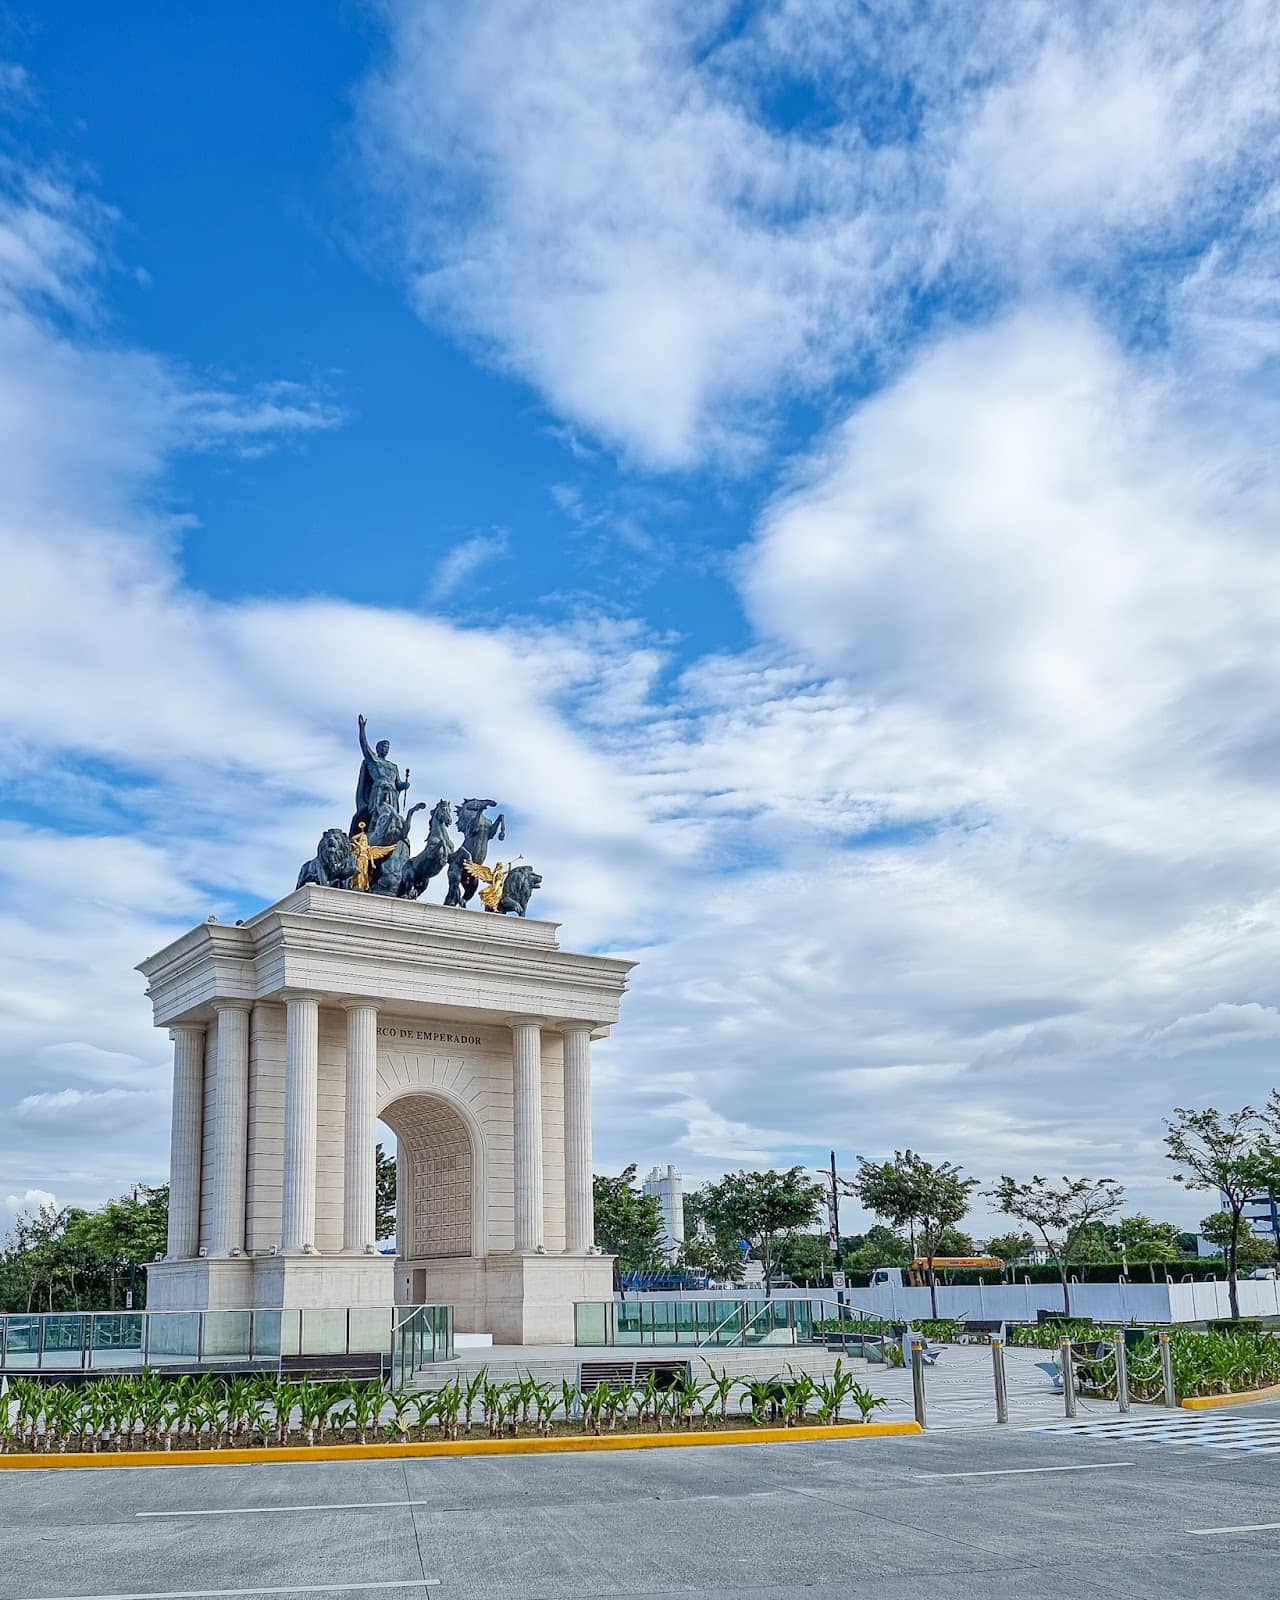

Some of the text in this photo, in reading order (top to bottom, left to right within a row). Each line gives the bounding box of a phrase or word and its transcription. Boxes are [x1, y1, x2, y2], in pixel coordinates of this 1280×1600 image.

[376, 1027, 481, 1045] RCO DE EMPERADOR
